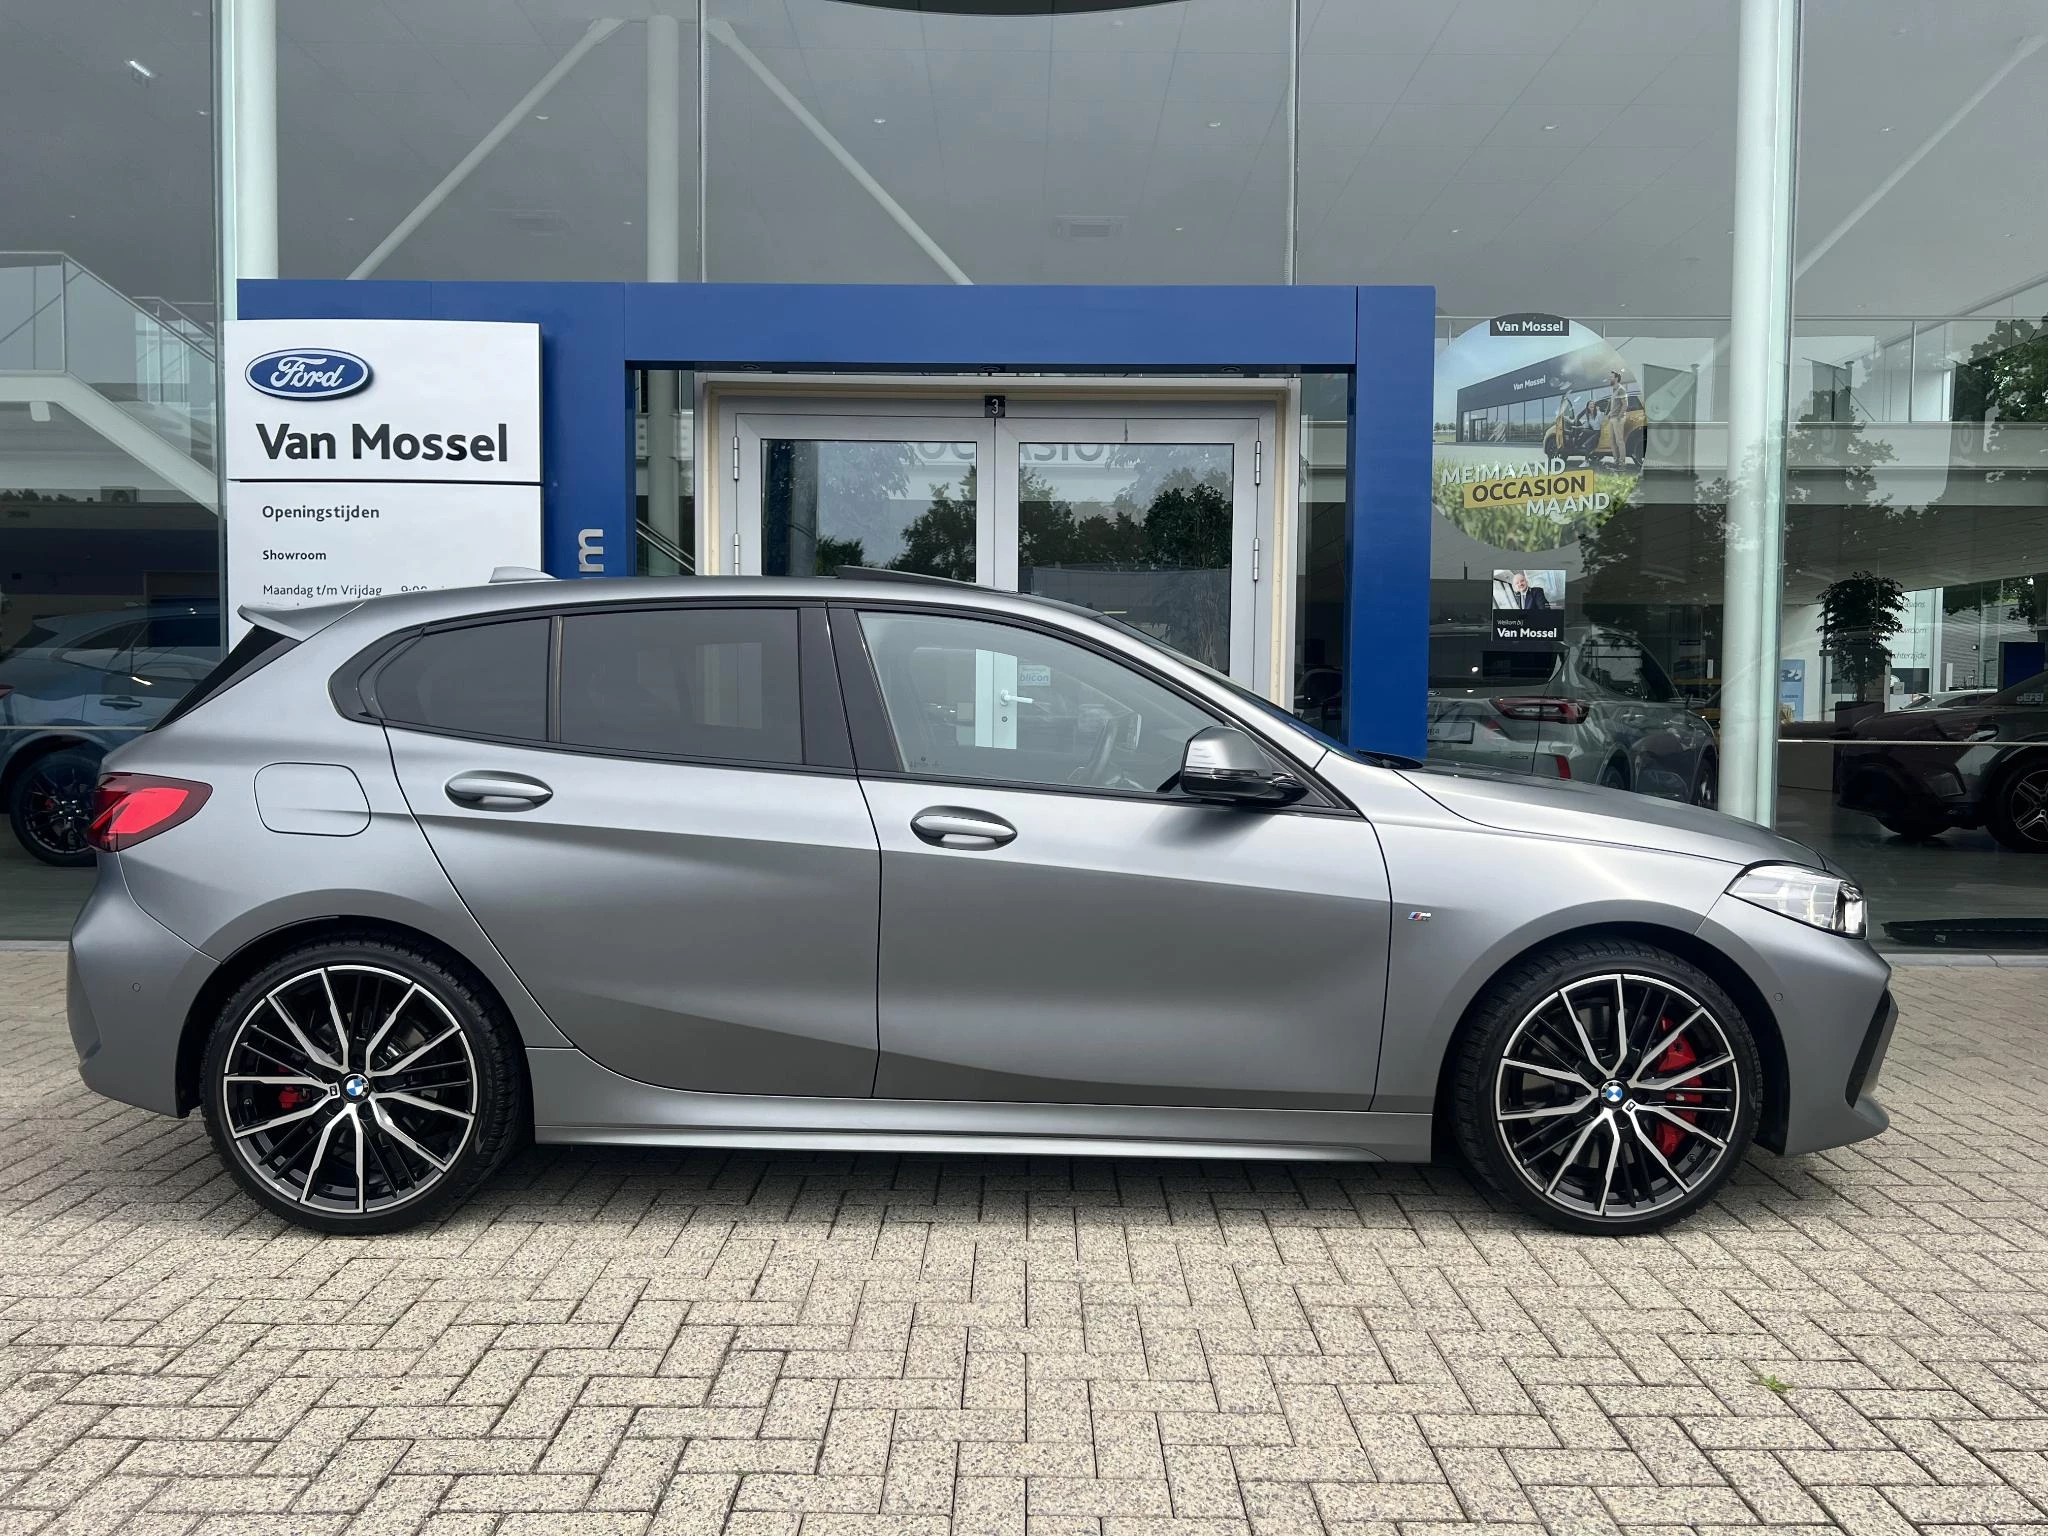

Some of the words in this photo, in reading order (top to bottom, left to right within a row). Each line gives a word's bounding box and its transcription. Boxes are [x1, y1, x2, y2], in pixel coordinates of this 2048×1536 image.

[1496, 320, 1519, 332] Van
[1522, 320, 1563, 332] Mossel
[270, 356, 345, 388] Ford
[1513, 383, 1524, 391] Van
[1524, 374, 1546, 389] Mossel
[991, 399, 999, 415] 3
[255, 423, 337, 460] Van
[352, 422, 508, 463] Mossel
[1472, 475, 1586, 502] OCCASION
[1526, 492, 1610, 517] MAAND
[262, 505, 380, 522] Openingstijden
[262, 550, 327, 561] Showroom
[263, 584, 313, 597] Maandag
[317, 584, 337, 595] t/m
[341, 584, 382, 598] Vrijdag
[1497, 627, 1518, 638] Van
[1520, 627, 1557, 638] Mossel
